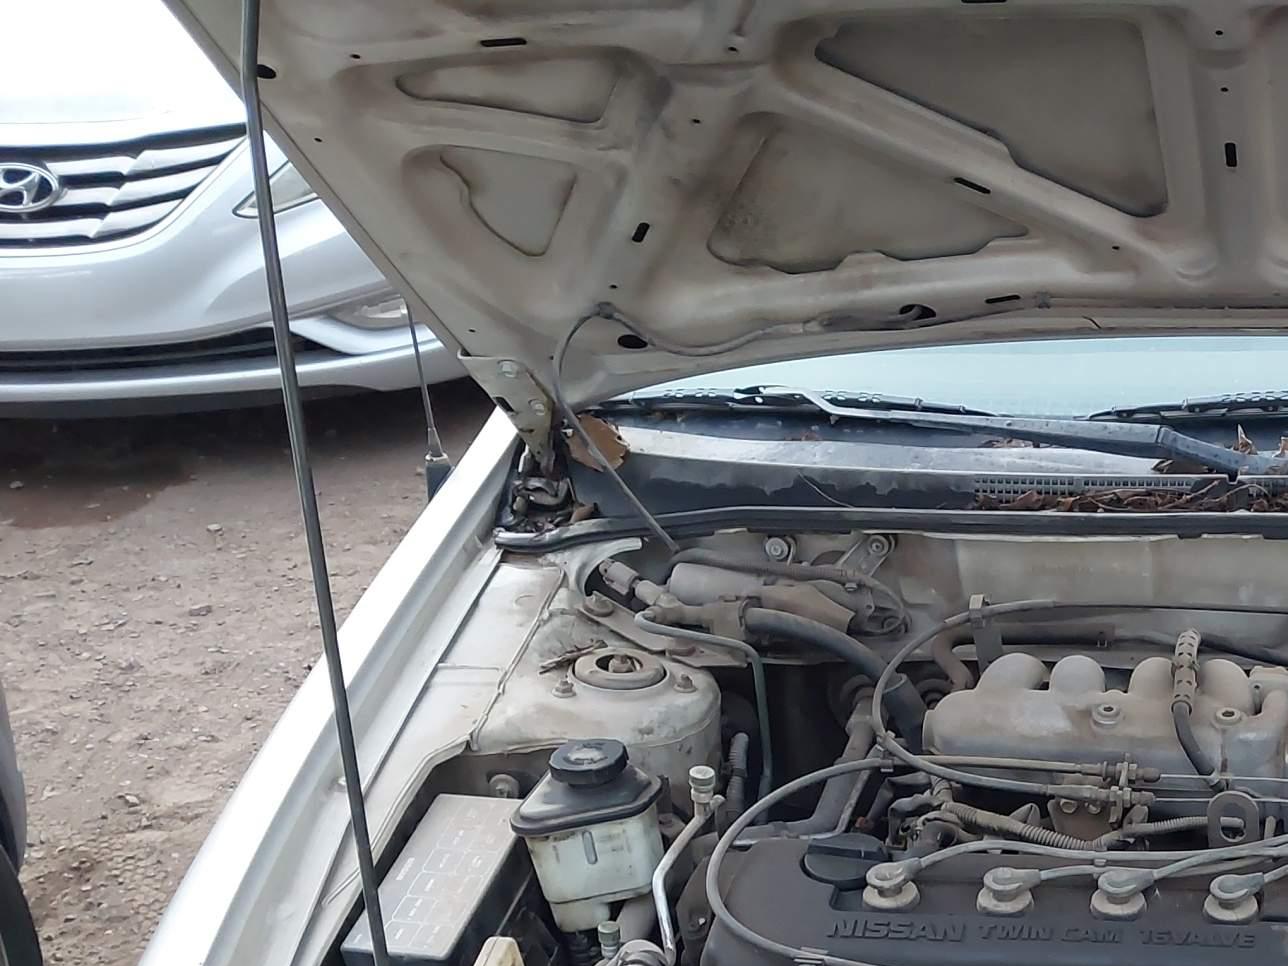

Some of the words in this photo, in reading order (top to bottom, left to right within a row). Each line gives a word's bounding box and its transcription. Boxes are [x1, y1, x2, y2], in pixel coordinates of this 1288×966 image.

[826, 918, 968, 942] NISSAN
[978, 924, 1055, 941] TWIN
[1061, 926, 1122, 945] CAM
